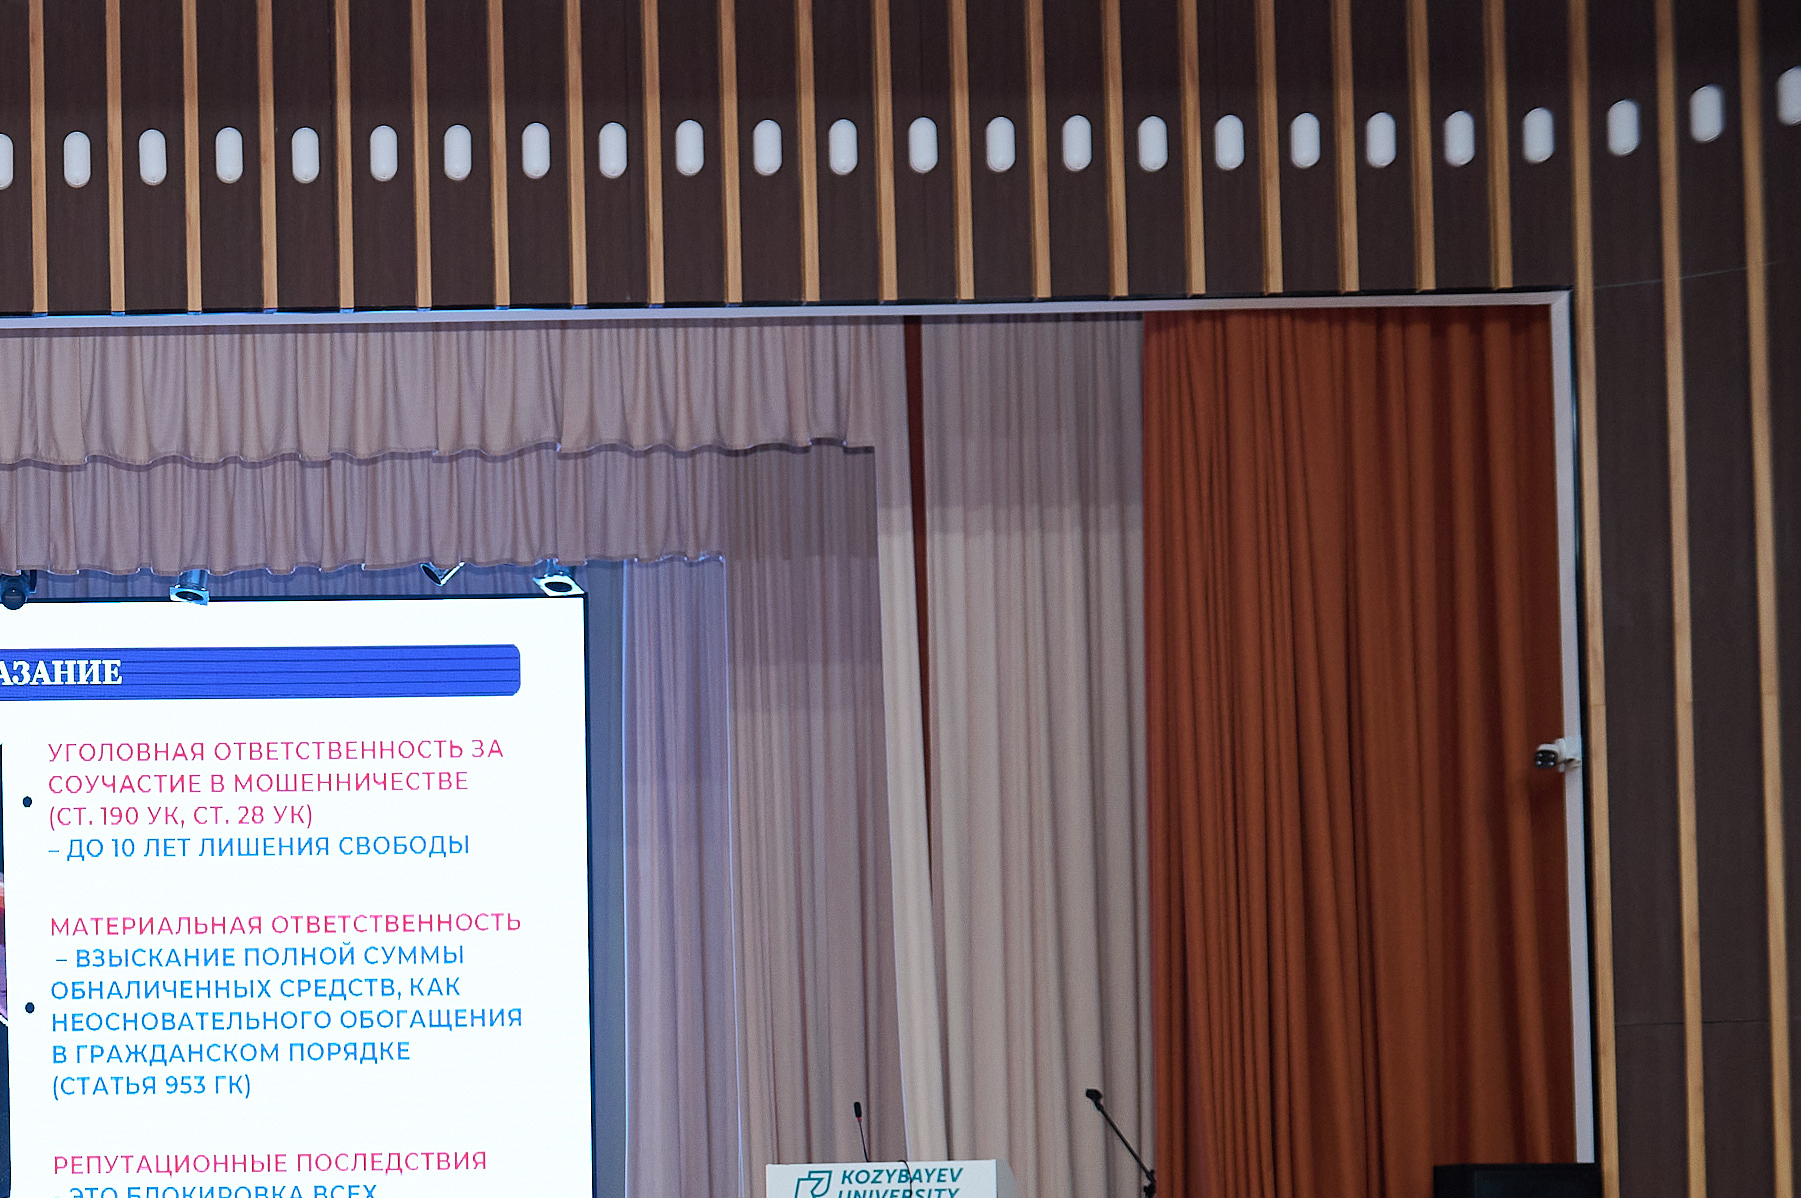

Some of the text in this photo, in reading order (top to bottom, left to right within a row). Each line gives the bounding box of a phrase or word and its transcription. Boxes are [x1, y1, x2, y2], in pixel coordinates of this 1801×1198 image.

[47, 738, 504, 763] УГОЛОВНАЯ ОТВЕТСТВЕННОСТЬ ЗА
[48, 771, 469, 795] СОУЧАСТИЕ В МОШЕННИЧЕСТВЕ
[49, 803, 312, 829] (СТ. 190 УК, СТ. 28 УК)
[66, 838, 104, 863] ДО
[111, 838, 136, 858] 10
[143, 837, 192, 858] ЛЕТ
[198, 836, 330, 857] ЛИШЕНИЯ
[338, 834, 470, 859] СВОБОДЫ
[51, 912, 521, 937] МАТЕРИАЛЬНАЯ ОТВЕТСТВЕННОСТЬ
[76, 947, 236, 969] ВЗЫСКАНИЕ
[244, 940, 355, 967] ПОЛНОЙ
[363, 944, 464, 966] СУММЫ
[50, 976, 461, 1002] ОБНАЛИЧЕННЫХ СРЕДСТВ, КАК
[52, 1007, 522, 1033] НЕОСНОВАТЕЛЬНОГО ОБОГАЩЕНИЯ
[52, 1040, 411, 1067] В ГРАЖДАНСКОМ ПОРЯДКЕ
[52, 1073, 251, 1101] (СТАТЬЯ 953 ГК)
[54, 1151, 487, 1179] РЕПУТАЦИОННЫЕ ПОСЛЕДСТВИЯ
[841, 1167, 964, 1184] KOZYBAYEV
